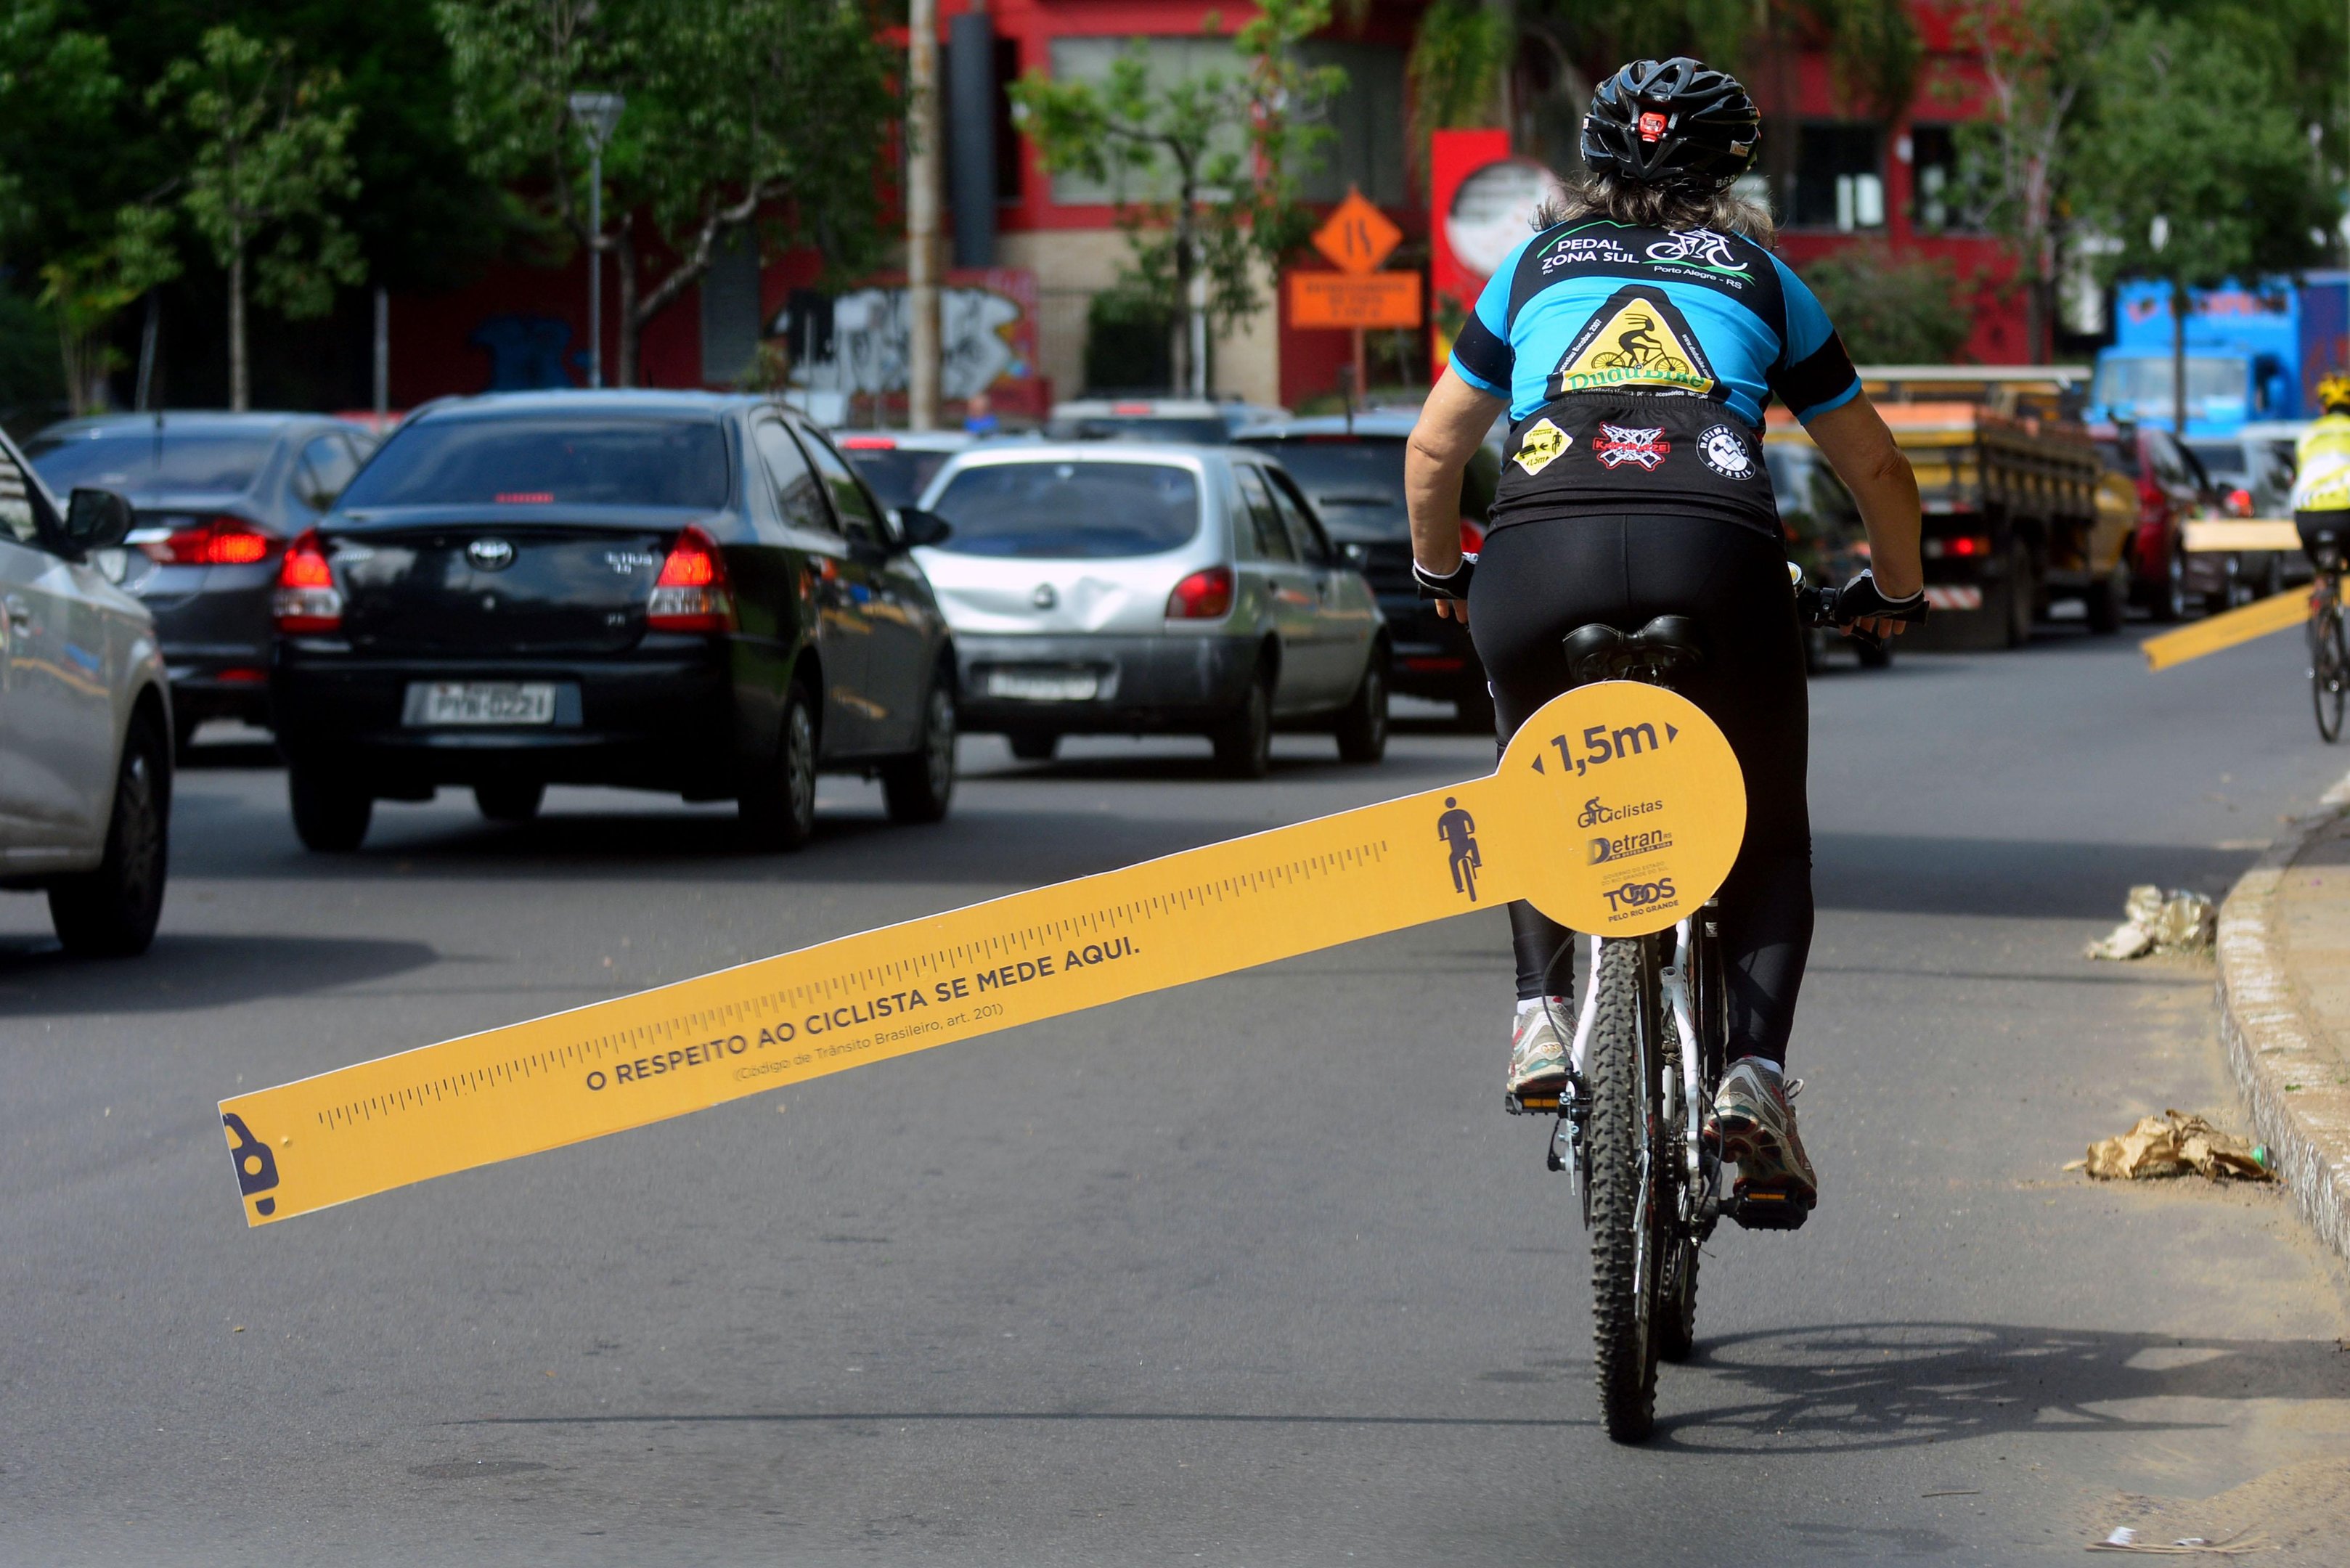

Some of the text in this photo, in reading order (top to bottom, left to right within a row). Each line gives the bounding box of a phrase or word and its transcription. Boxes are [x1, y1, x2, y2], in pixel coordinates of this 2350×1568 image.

[1541, 250, 1639, 270] ZONA SUL
[1557, 238, 1624, 252] PEDAL
[1654, 265, 1682, 274] Porto
[1684, 269, 1717, 281] Alegre
[1726, 279, 1742, 290] RS
[1550, 722, 1659, 777] 1,5m
[1587, 830, 1662, 866] Detran
[1608, 899, 1679, 922] PELO RIO GRANDE
[587, 936, 1141, 1091] O RESPEITO AO CICLISTA SE MEDE AQUI.
[793, 1052, 812, 1066] de
[815, 1038, 870, 1059] Trânsito
[875, 1019, 943, 1045] Brasileiro,
[947, 1013, 970, 1027] art.
[974, 1003, 1004, 1021] 201)
